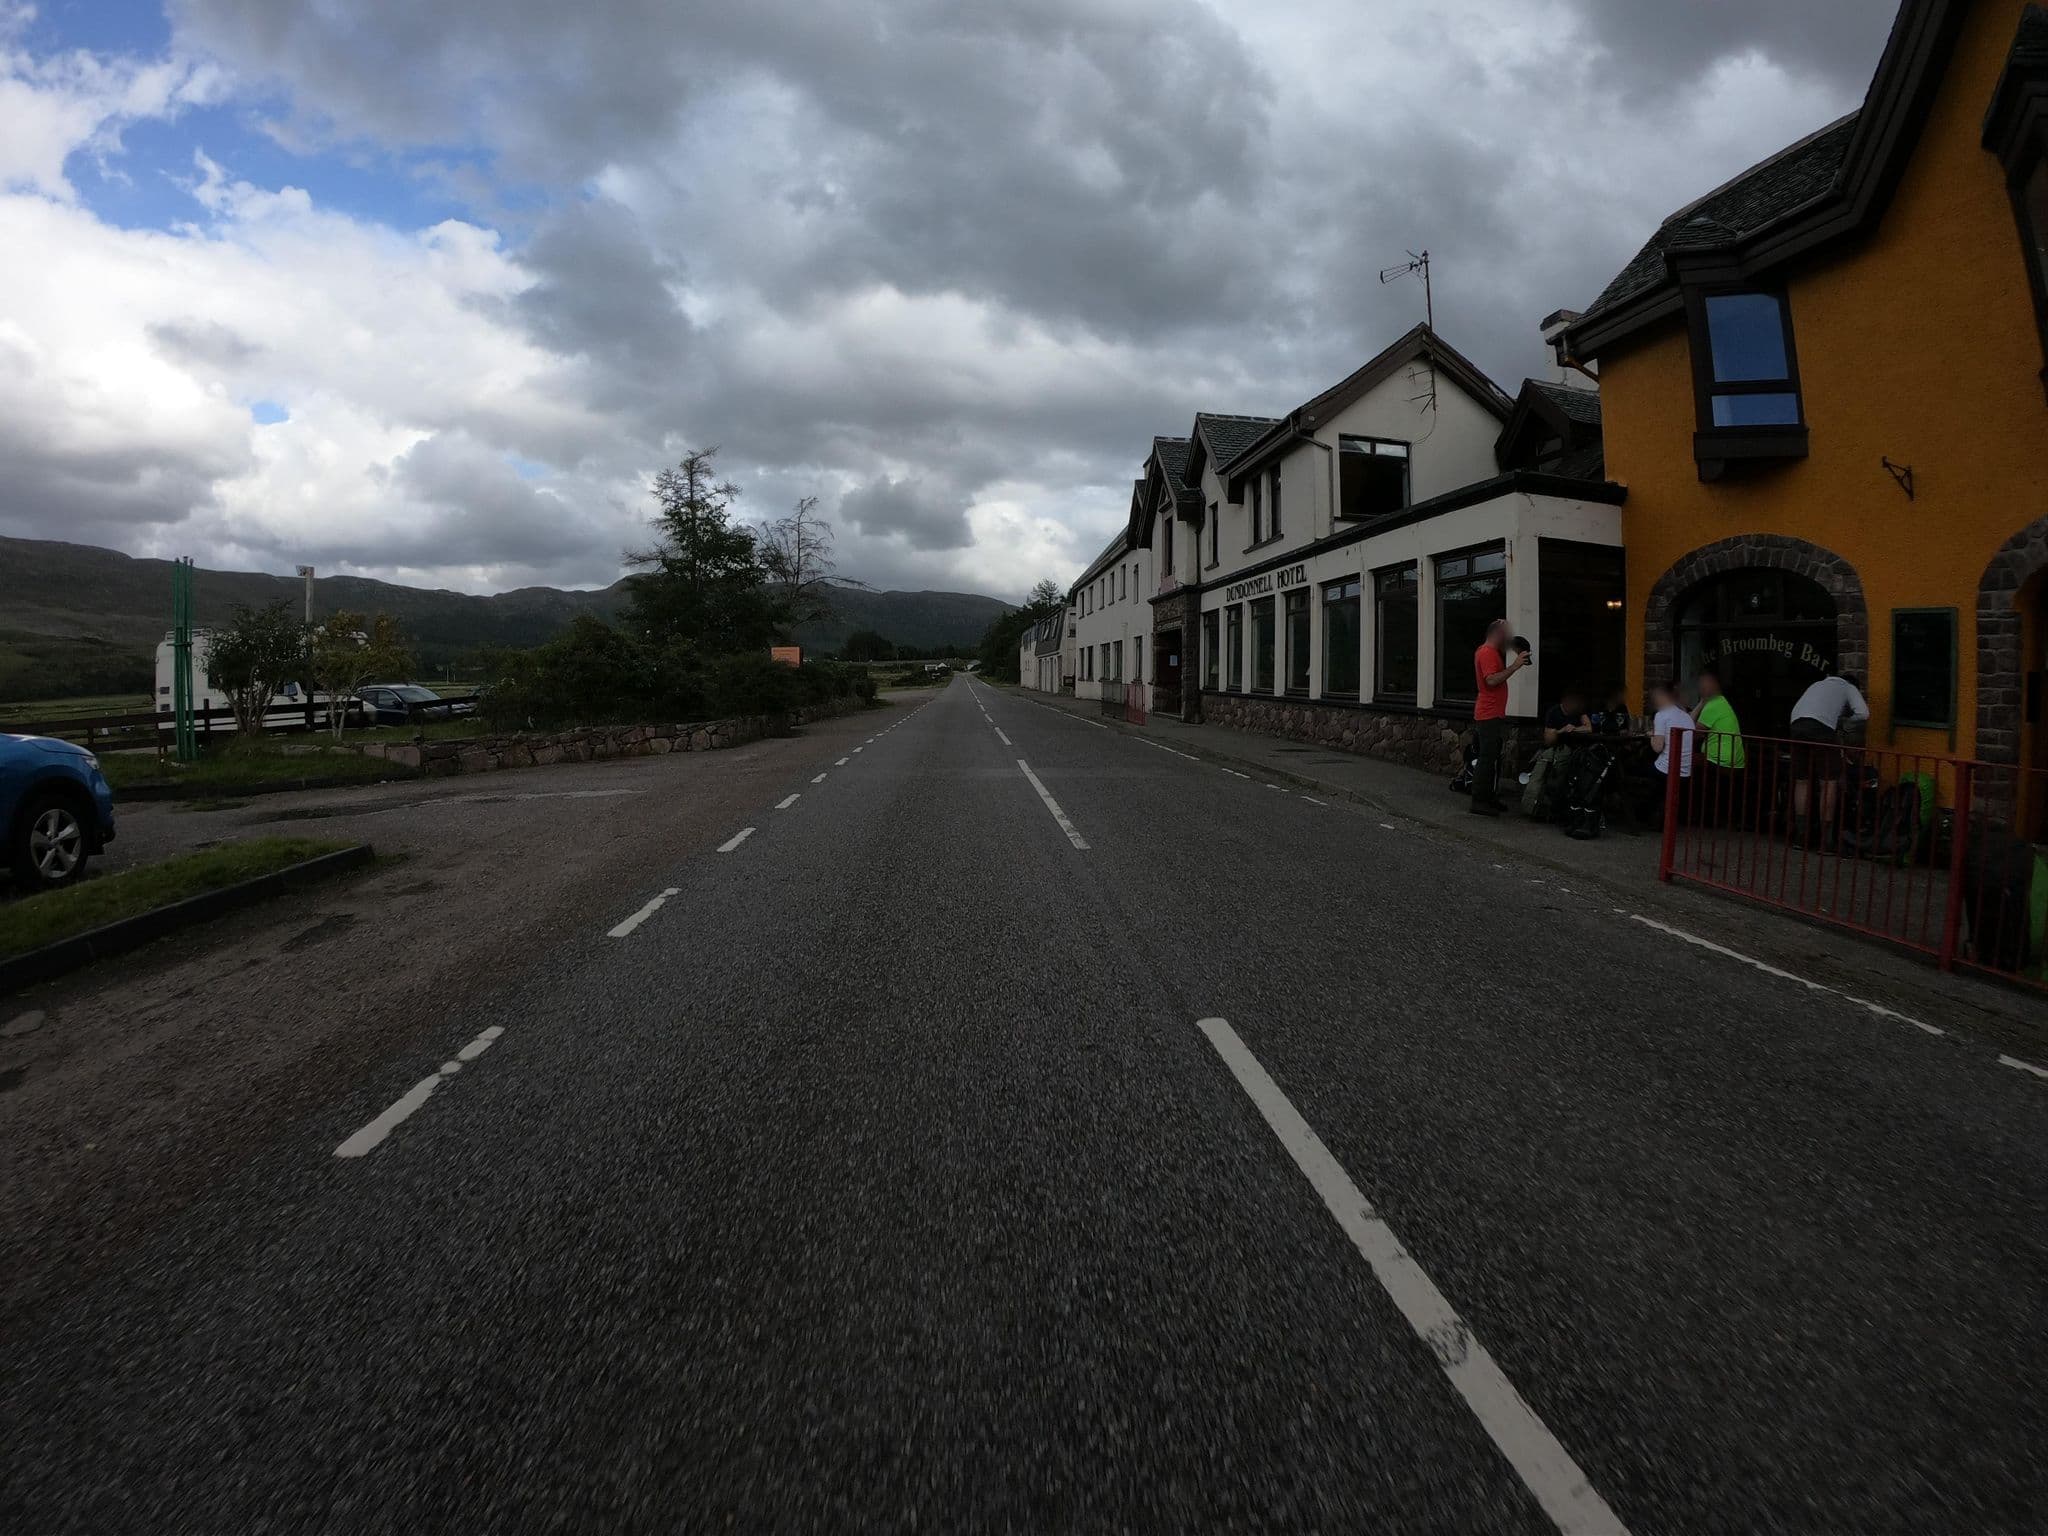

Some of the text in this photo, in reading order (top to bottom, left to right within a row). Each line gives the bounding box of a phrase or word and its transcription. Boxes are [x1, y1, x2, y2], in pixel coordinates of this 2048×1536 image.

[1226, 564, 1307, 602] DUNDONNELL HOTEL
[1721, 633, 1794, 658] Broombeg
[1800, 642, 1831, 672] Bar
